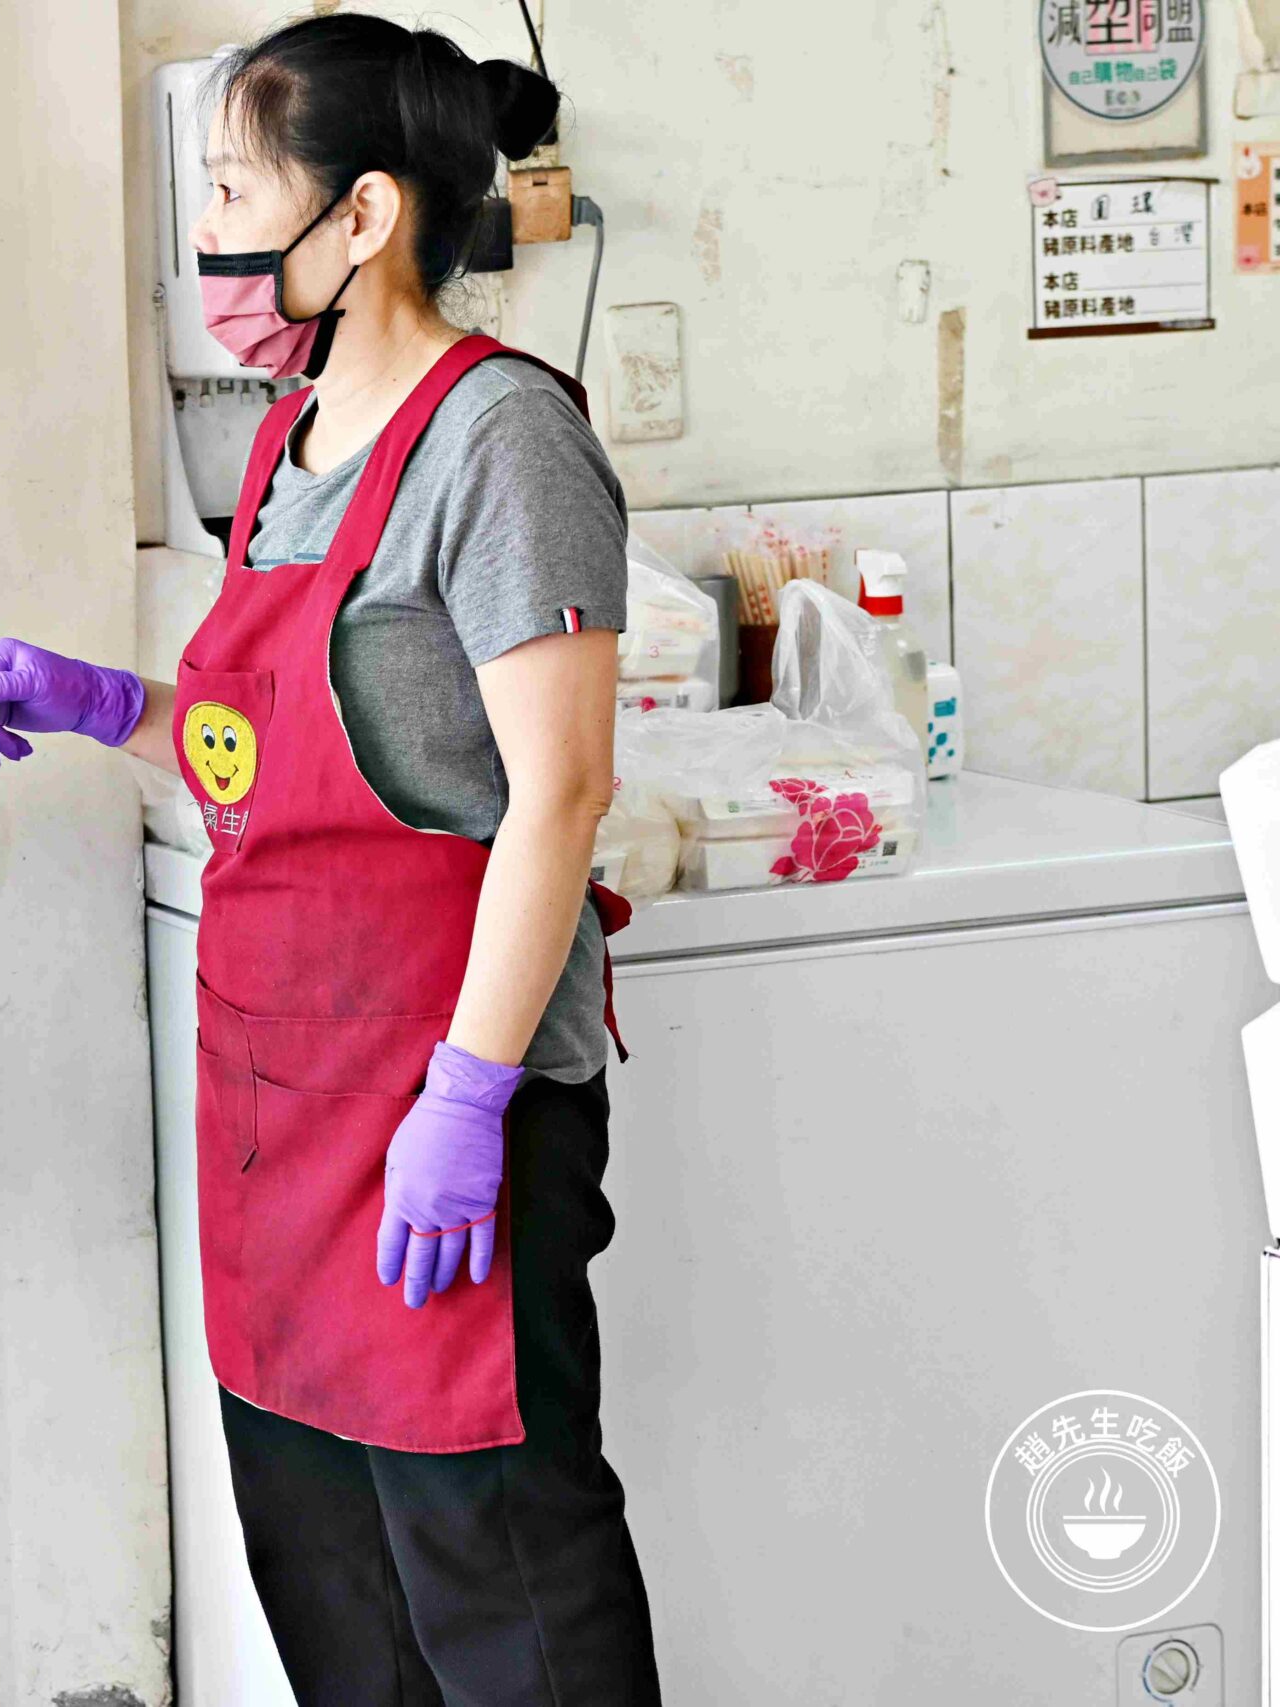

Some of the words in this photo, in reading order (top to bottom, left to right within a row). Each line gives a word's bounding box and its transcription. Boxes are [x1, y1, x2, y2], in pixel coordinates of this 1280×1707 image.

[1043, 209, 1078, 229] 本店
[1043, 233, 1134, 256] 豬原料產地
[1043, 271, 1079, 291] 本店
[1044, 295, 1136, 319] 豬原料產地
[649, 645, 660, 659] 3
[204, 801, 249, 837] 氣生
